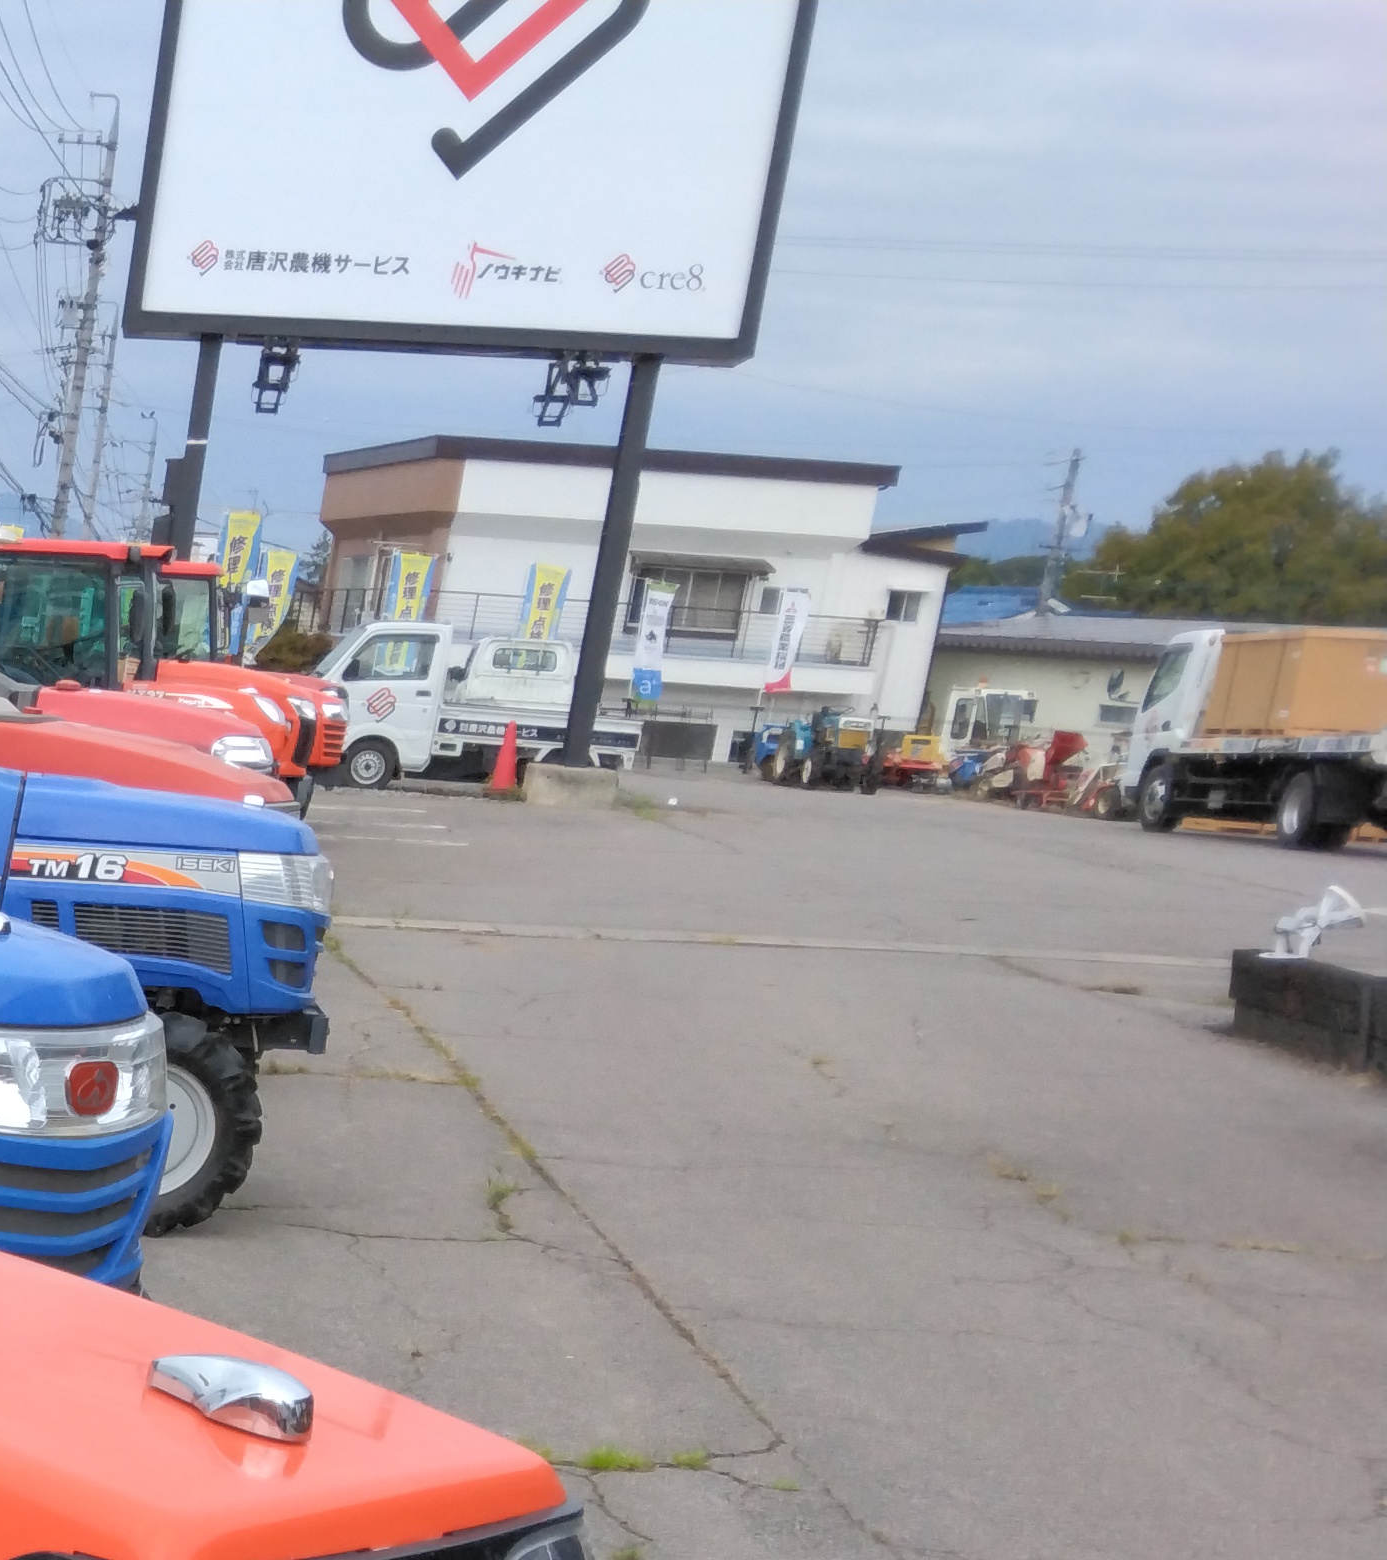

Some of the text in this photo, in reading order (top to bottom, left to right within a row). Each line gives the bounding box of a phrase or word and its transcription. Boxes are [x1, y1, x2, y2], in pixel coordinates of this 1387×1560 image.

[640, 263, 704, 291] cre8
[29, 854, 235, 881] TM16 ISEKI
